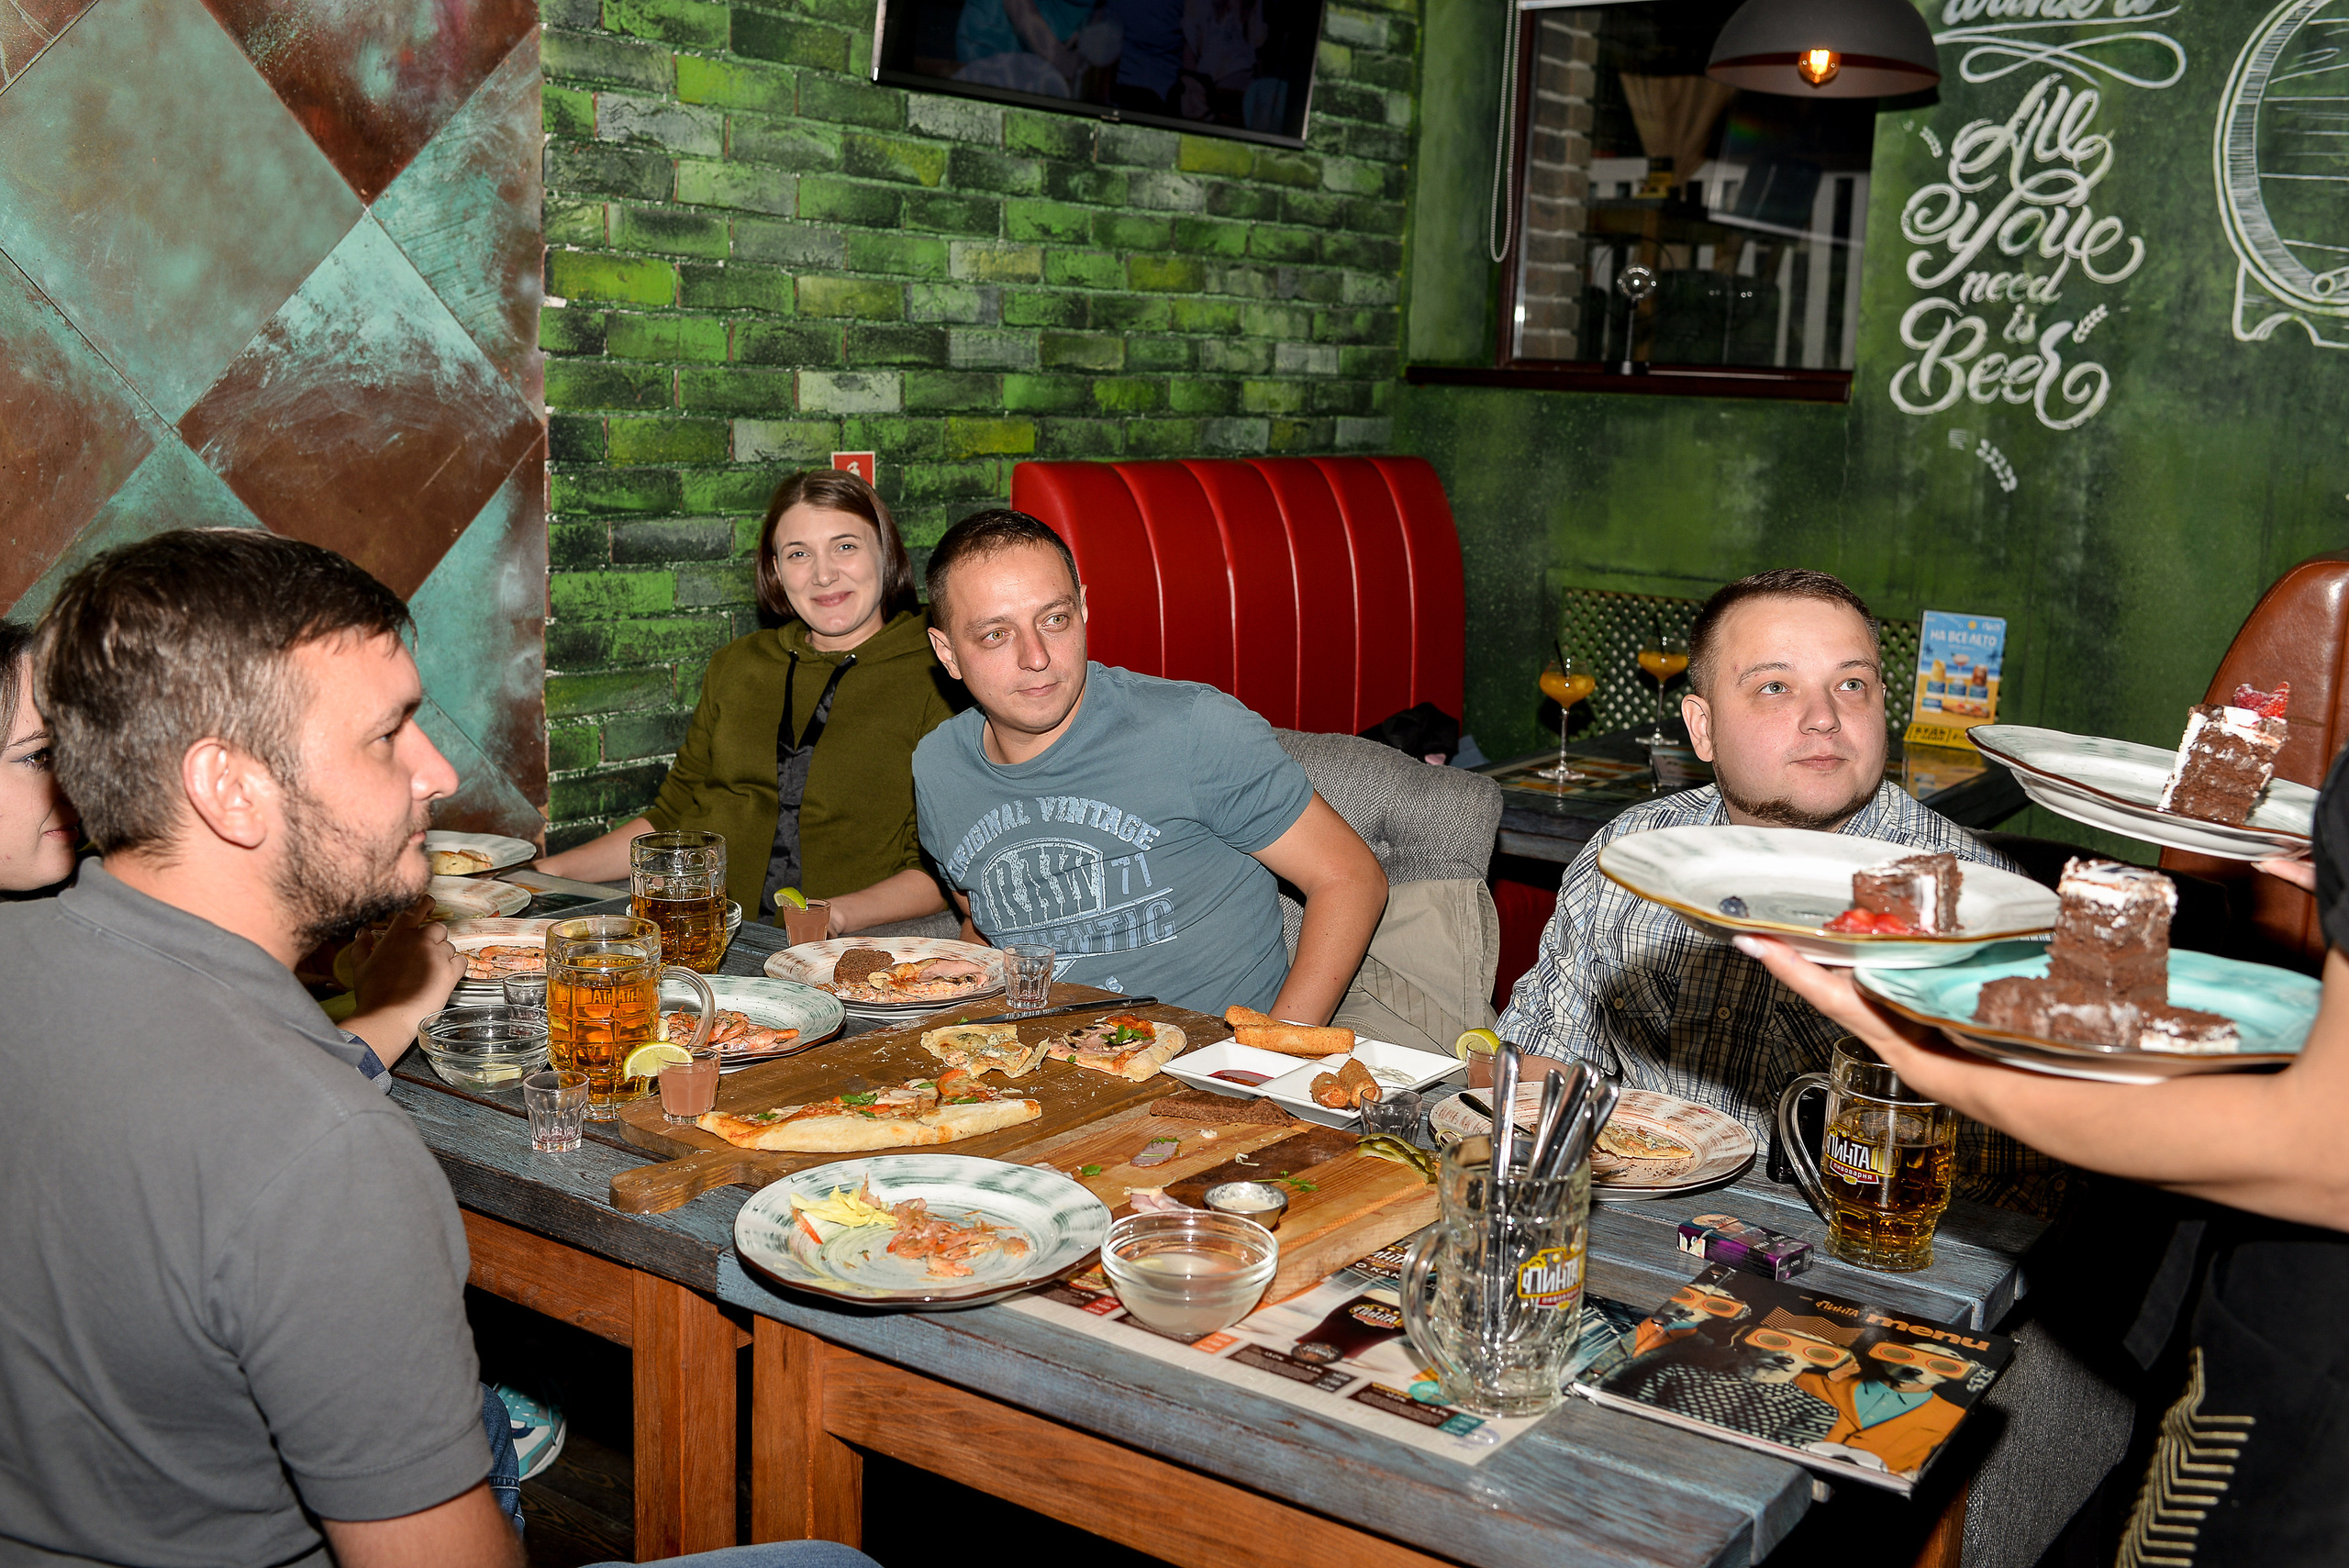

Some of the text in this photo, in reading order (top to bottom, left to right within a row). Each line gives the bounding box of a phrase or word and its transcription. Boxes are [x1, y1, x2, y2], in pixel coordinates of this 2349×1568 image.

[1958, 256, 2070, 305] need
[2001, 304, 2036, 344] is
[1930, 628, 1946, 641] НА
[1947, 630, 1967, 644] ВСЕ
[1969, 633, 1998, 648] ЛЕТО
[947, 795, 1161, 882] ORIGINAL VINTAGE
[1827, 1133, 1871, 1172] ПИНТА
[1353, 1304, 1398, 1324] ПИНТА
[1815, 1299, 1860, 1318] ПИНТА
[1865, 1313, 1991, 1352] menu
